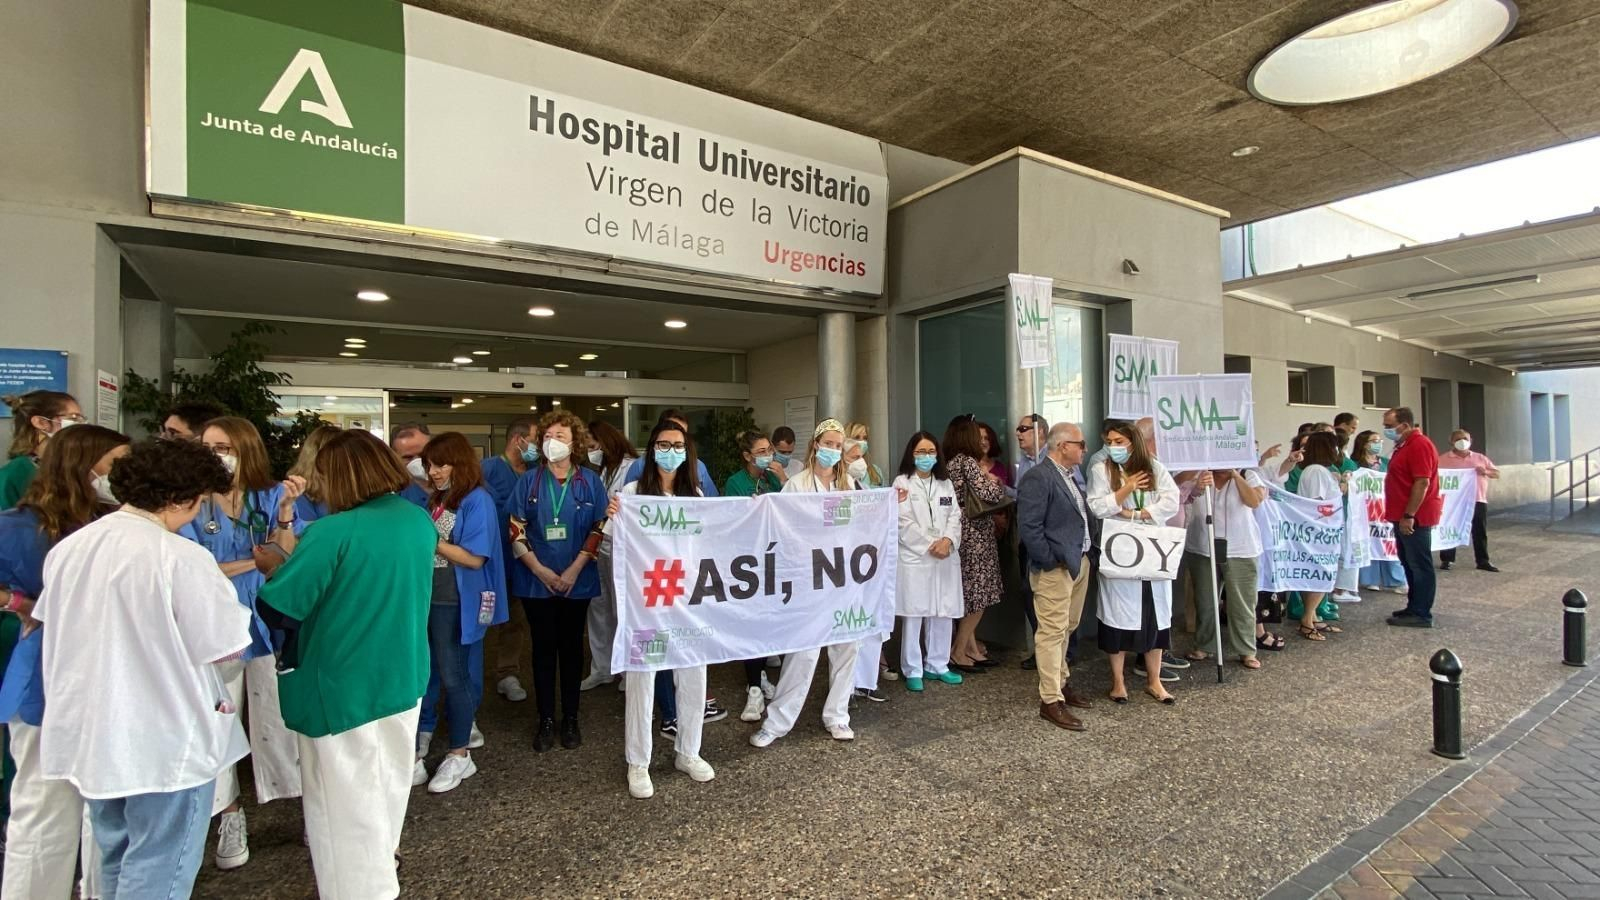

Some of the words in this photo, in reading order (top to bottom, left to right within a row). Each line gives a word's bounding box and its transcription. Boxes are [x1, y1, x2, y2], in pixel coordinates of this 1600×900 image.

[201, 112, 264, 136] Junta
[270, 123, 296, 142] de
[301, 130, 398, 159] Andalucía
[529, 95, 680, 164] Hospital
[699, 138, 870, 207] Universitario
[586, 162, 682, 207] Virgen
[701, 190, 735, 217] de
[752, 198, 772, 225] la
[787, 205, 869, 243] Victoria
[585, 213, 619, 237] de
[632, 219, 725, 257] Málaga
[764, 240, 866, 277] Urgencias
[1158, 393, 1239, 433] SMA
[1215, 440, 1247, 450] Málaga
[639, 504, 700, 530] SMA
[1105, 532, 1181, 572] OY
[643, 542, 792, 607] #ASÍ,
[812, 544, 878, 591] NO
